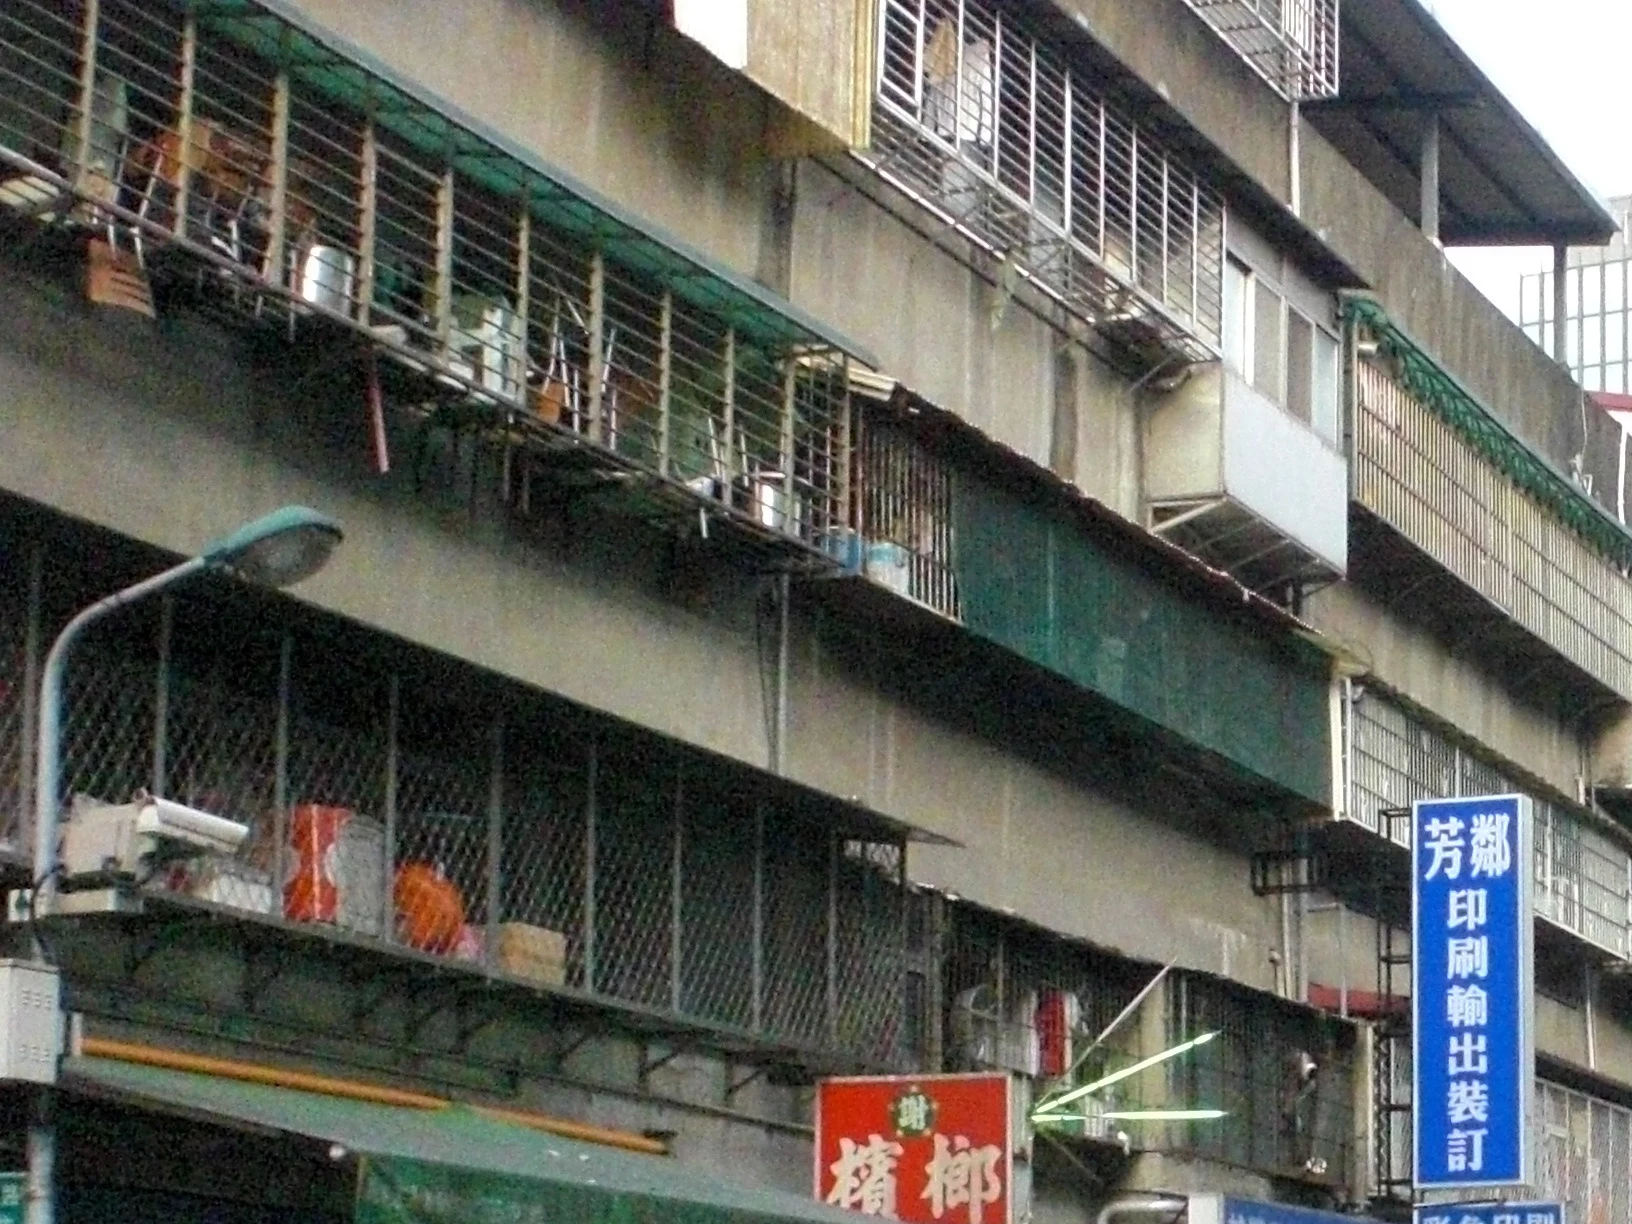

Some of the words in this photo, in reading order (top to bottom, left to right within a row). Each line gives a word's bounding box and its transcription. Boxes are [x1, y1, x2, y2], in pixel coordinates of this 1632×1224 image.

[1424, 813, 1511, 880] 芳鄰
[1446, 887, 1489, 1173] 印刷輸出裝訂
